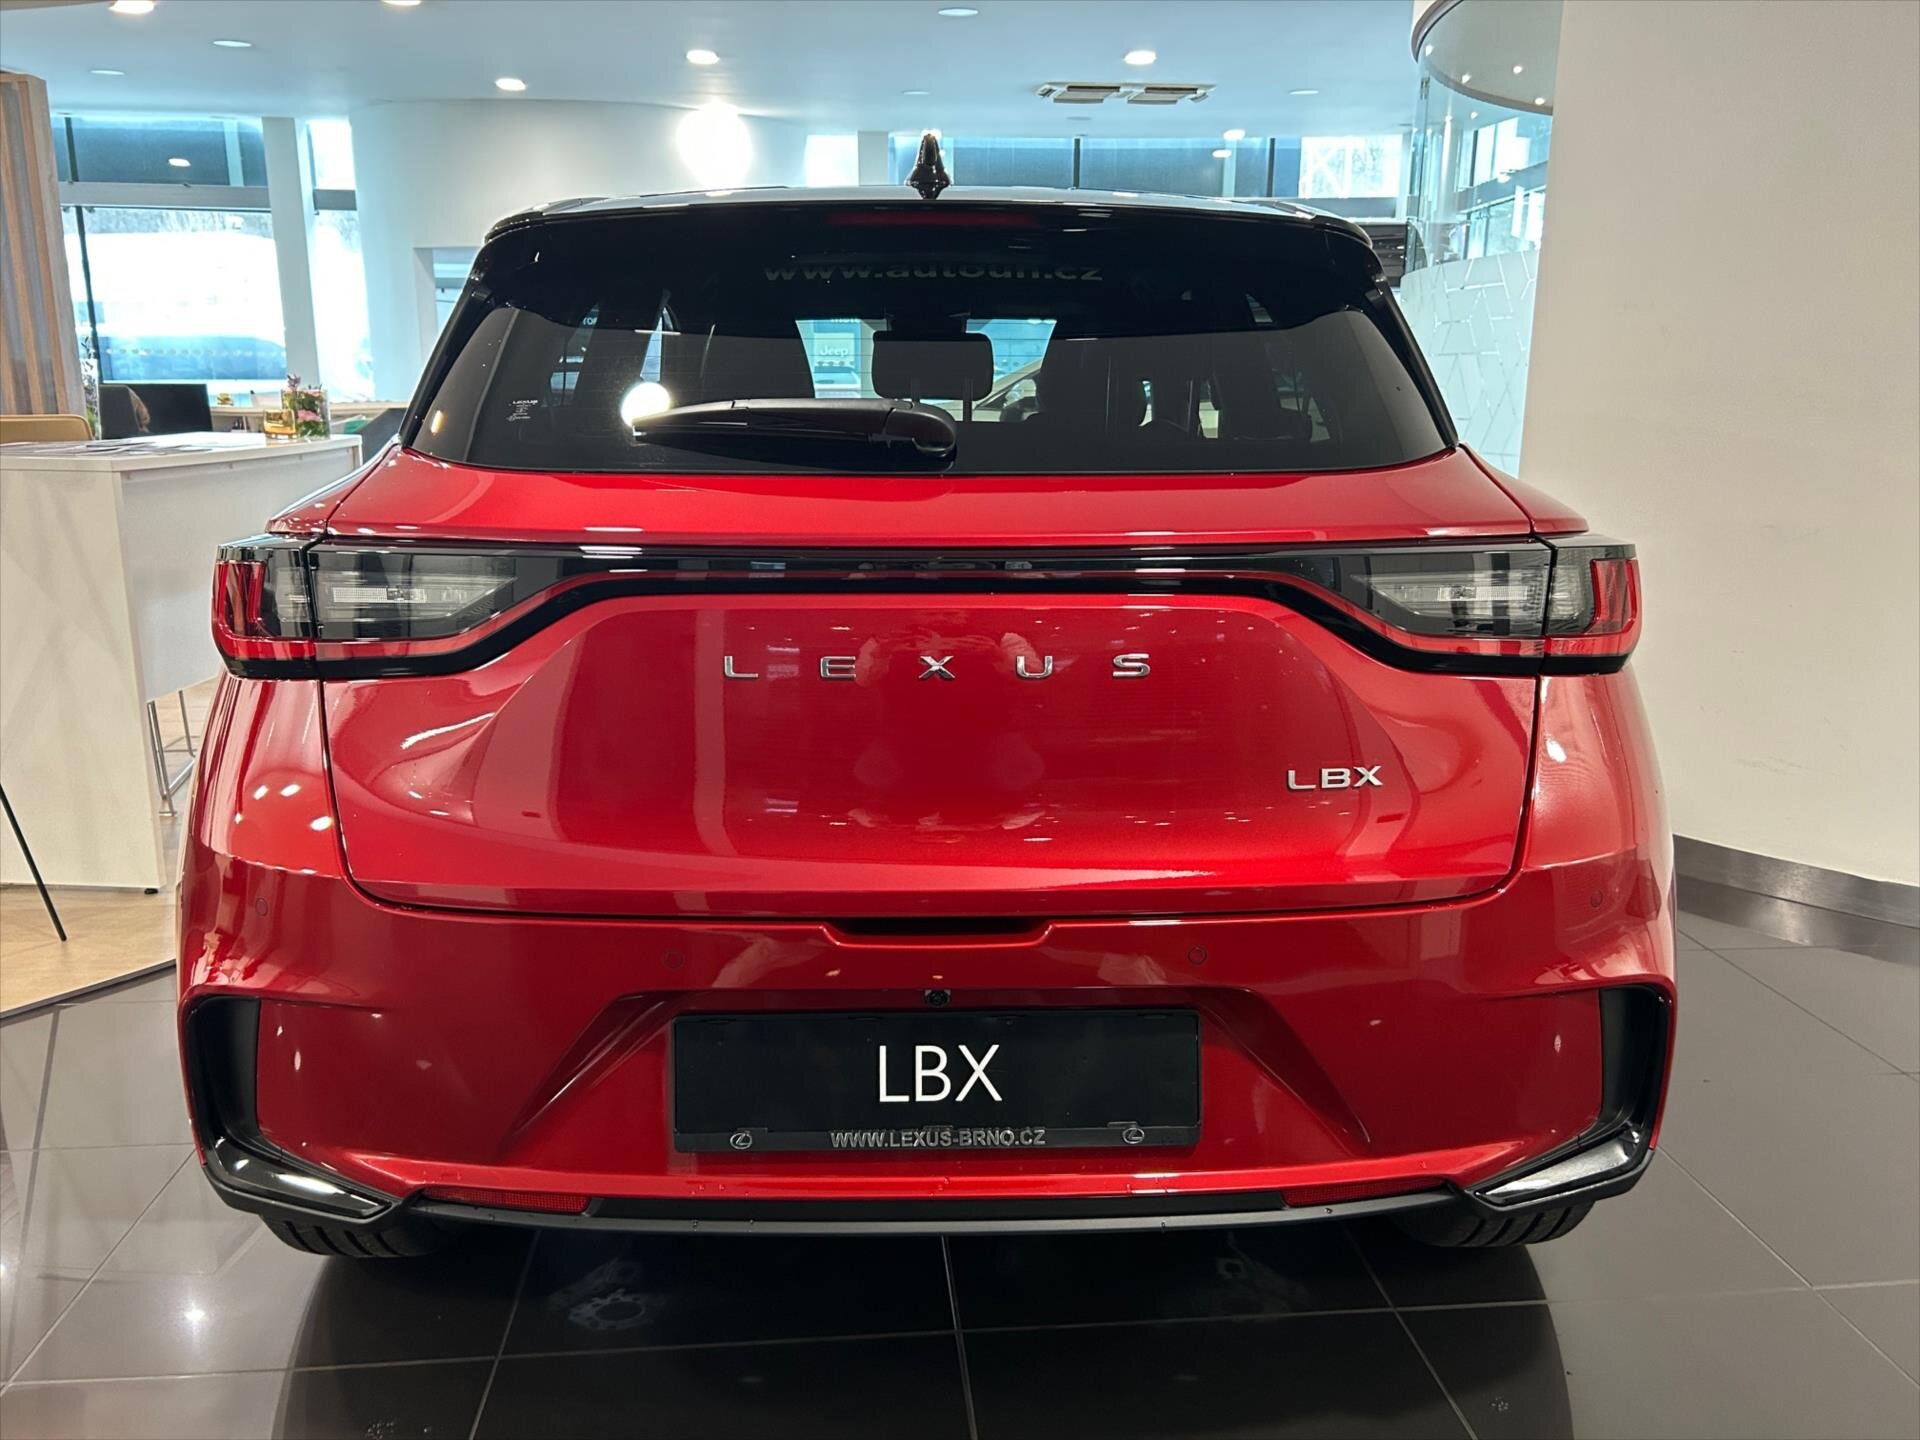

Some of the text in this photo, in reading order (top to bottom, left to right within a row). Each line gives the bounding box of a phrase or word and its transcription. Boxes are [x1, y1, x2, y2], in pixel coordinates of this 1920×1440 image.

[723, 653, 1151, 680] LEXUS
[1287, 765, 1383, 790] LBX
[878, 1044, 1002, 1103] LBX
[830, 1129, 1046, 1149] WWW.LEXUS-BRNO.CZ
